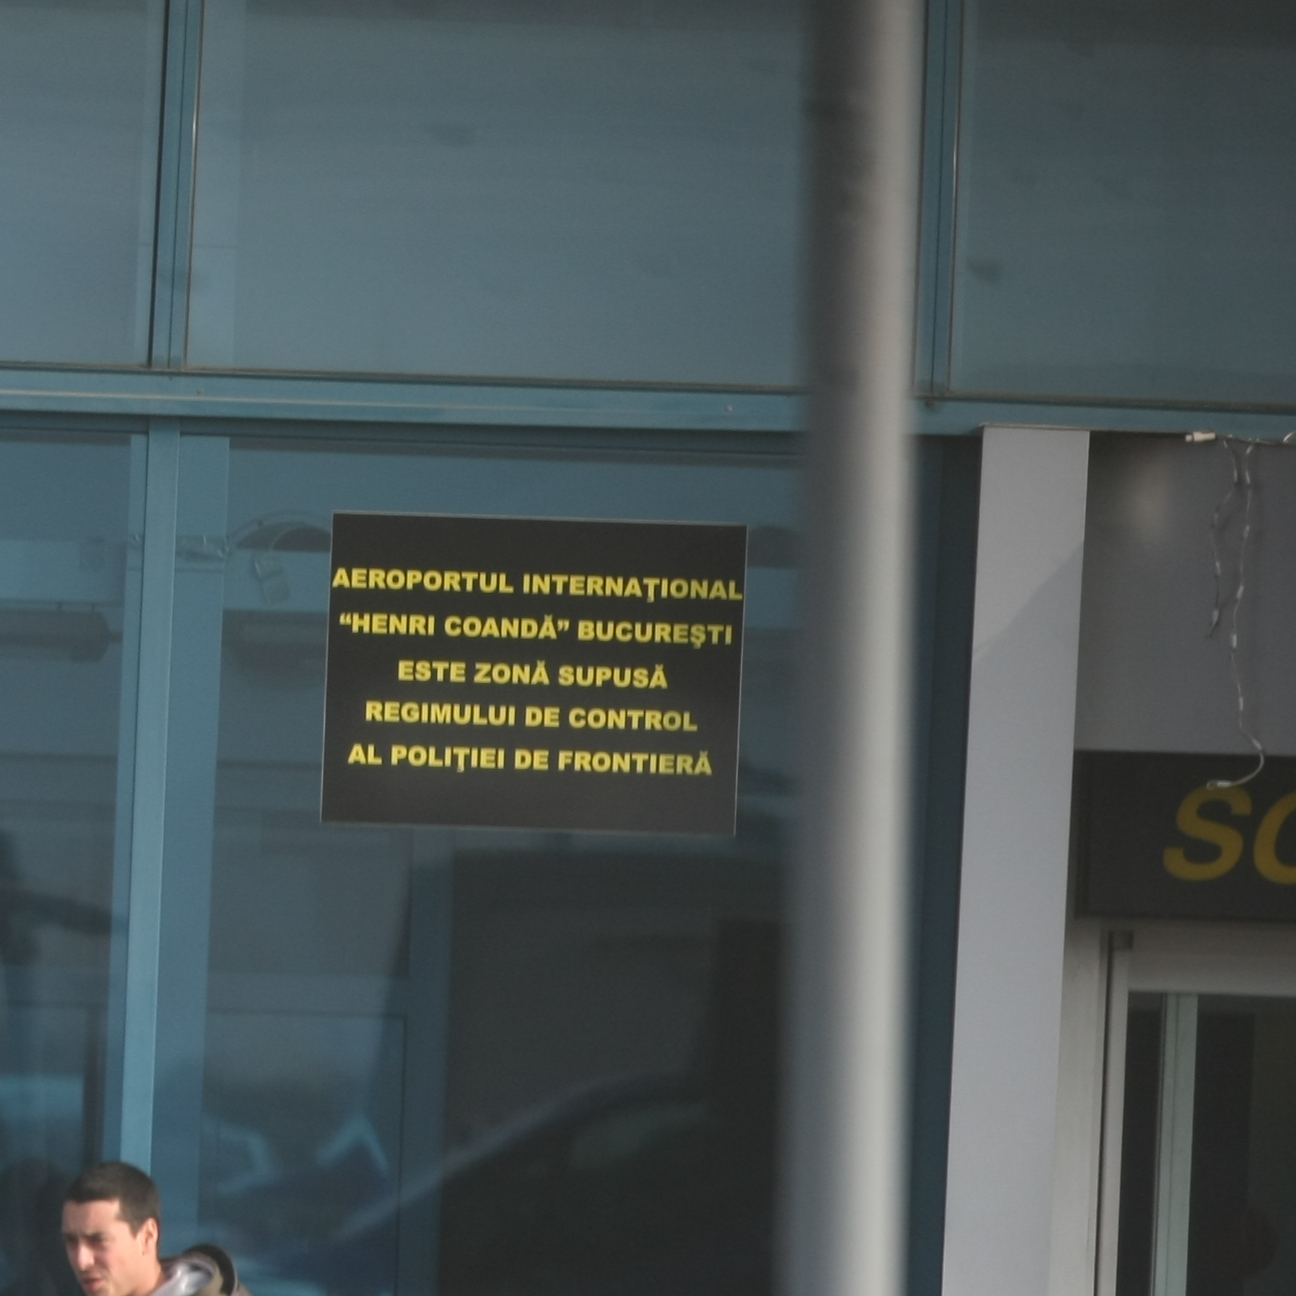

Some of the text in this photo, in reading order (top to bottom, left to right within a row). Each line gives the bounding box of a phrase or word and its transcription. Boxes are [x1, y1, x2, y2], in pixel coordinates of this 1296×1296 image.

[332, 566, 515, 595] AEROPORTUL
[397, 658, 669, 689] ESTE ZONĂ SUPUSĂ
[364, 700, 698, 732] REGIMULUI DE CONTROL
[347, 743, 384, 766] AL
[513, 747, 550, 771] DE
[557, 749, 713, 775] FRONTIERĂ
